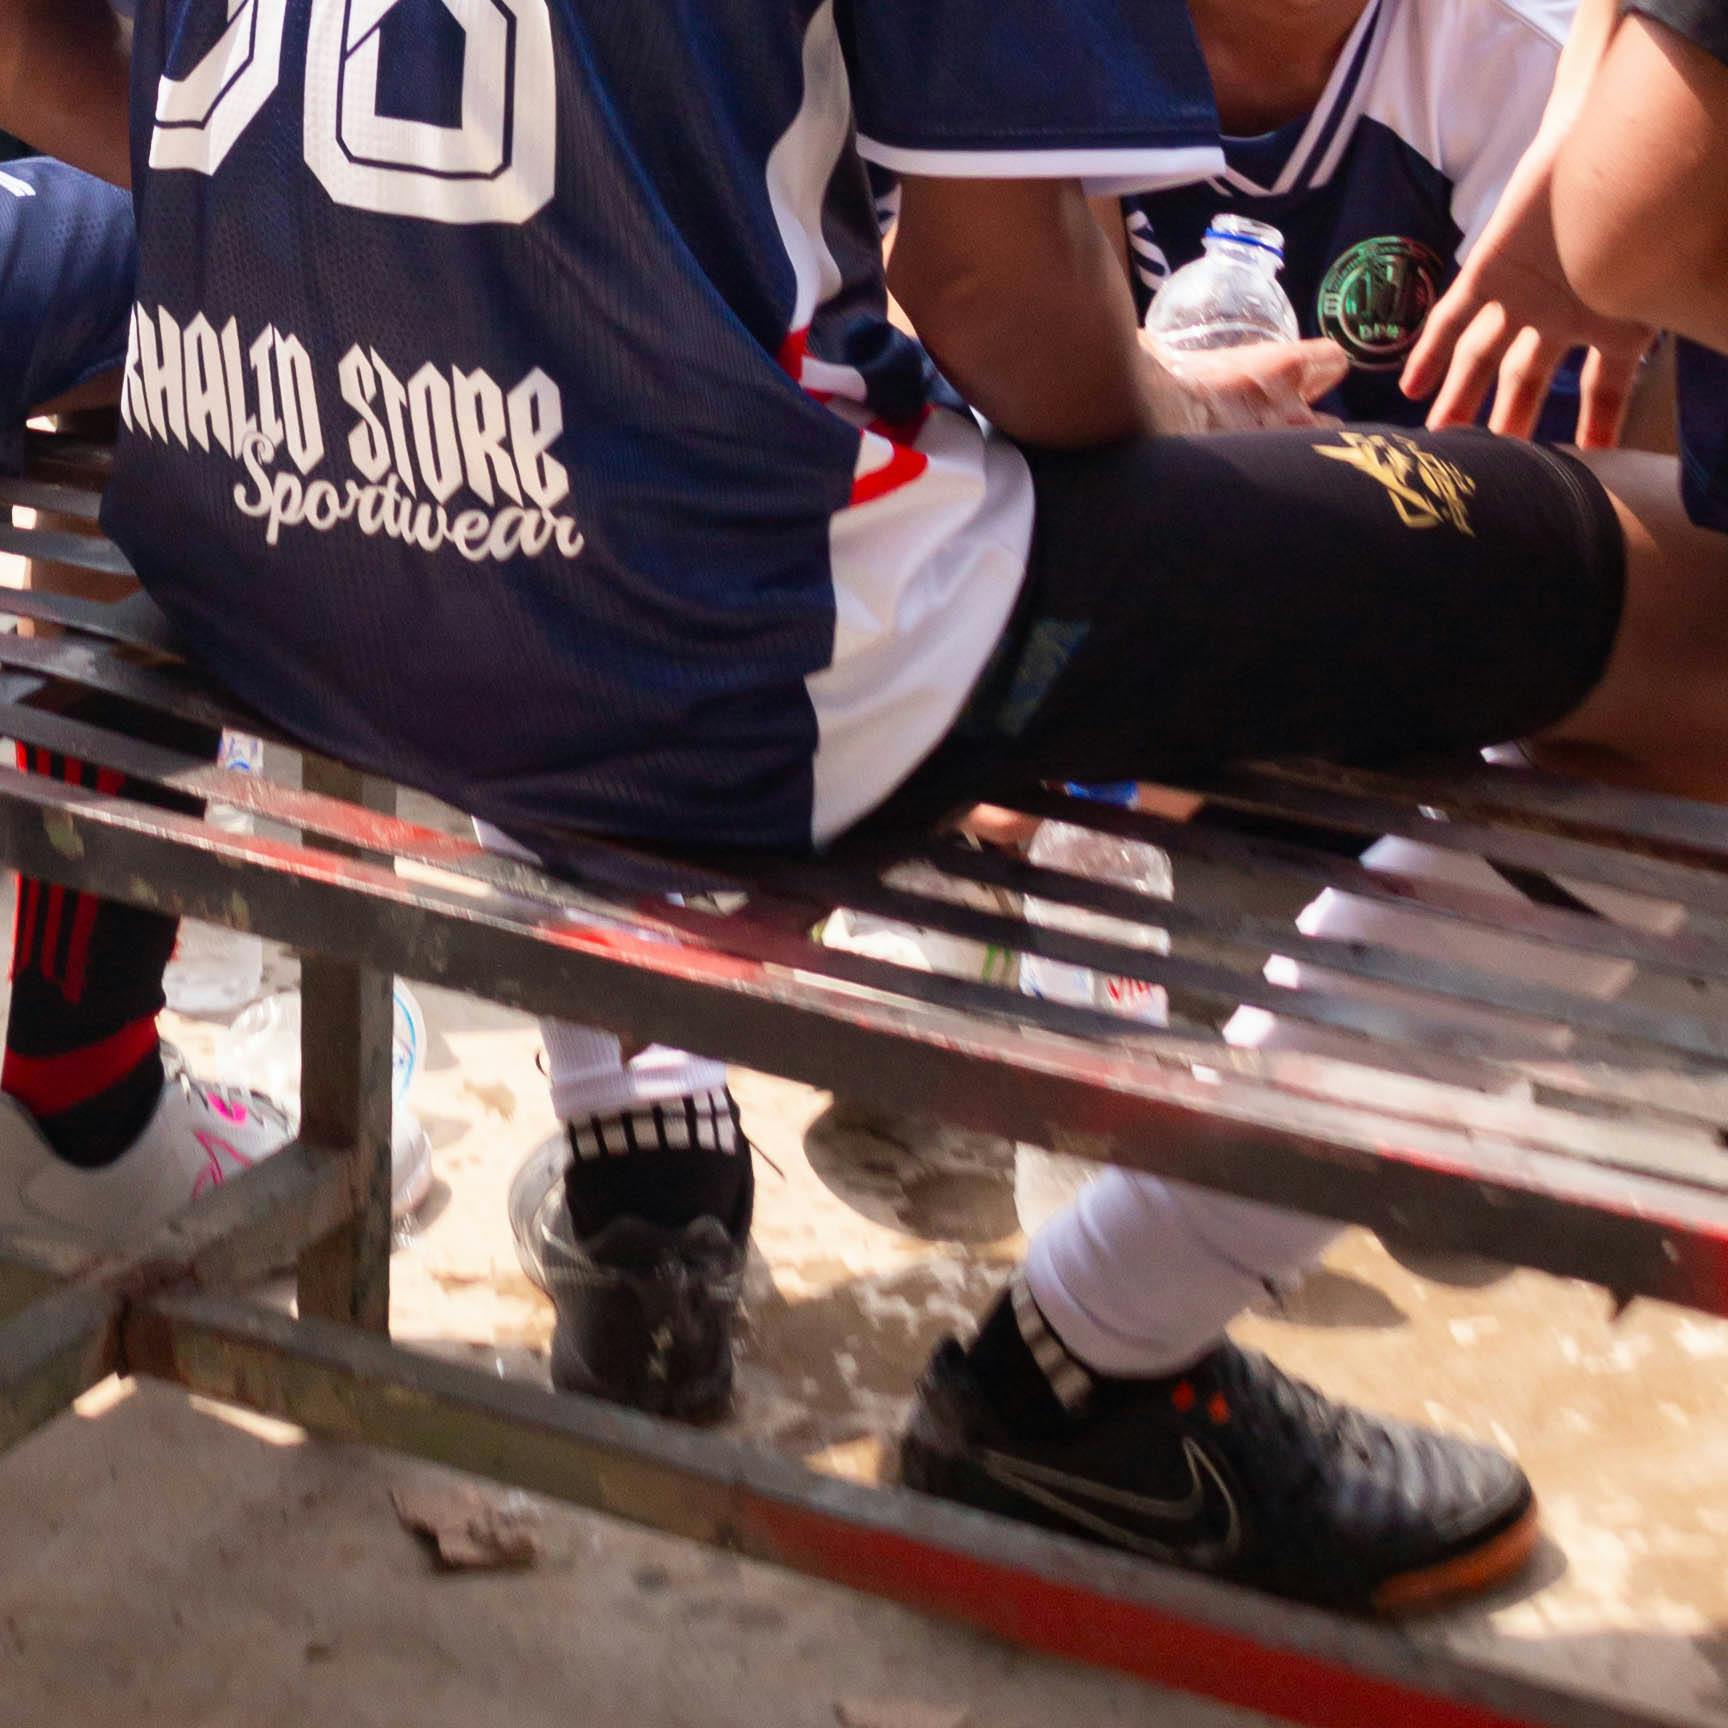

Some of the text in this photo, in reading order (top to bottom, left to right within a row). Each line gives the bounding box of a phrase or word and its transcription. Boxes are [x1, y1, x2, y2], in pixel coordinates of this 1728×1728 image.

[120, 300, 571, 511] KHALID STORE
[232, 430, 585, 562] Sportwear
